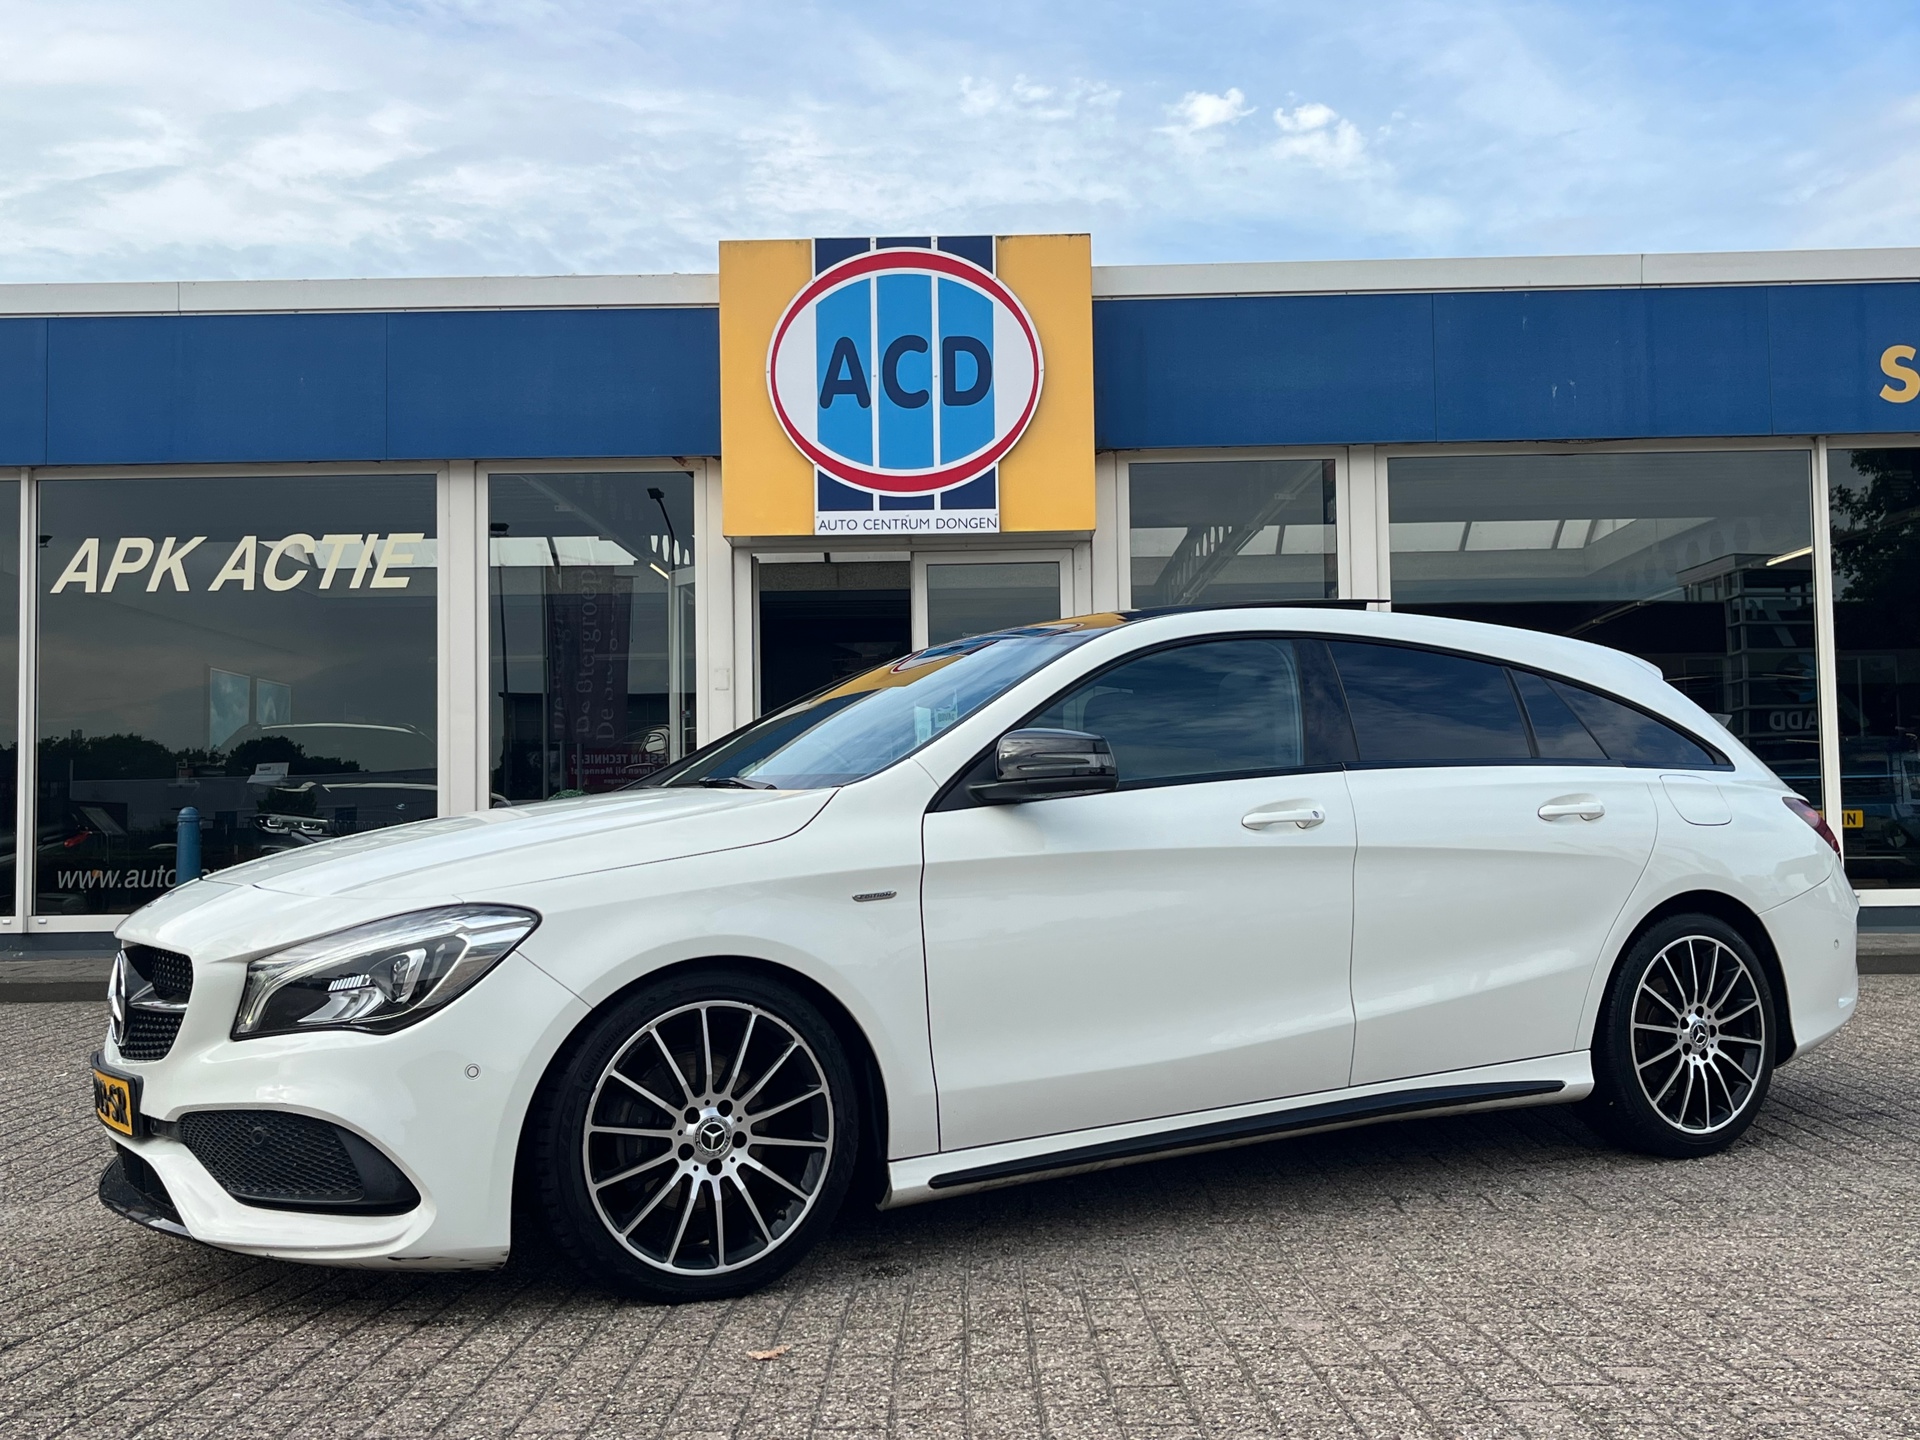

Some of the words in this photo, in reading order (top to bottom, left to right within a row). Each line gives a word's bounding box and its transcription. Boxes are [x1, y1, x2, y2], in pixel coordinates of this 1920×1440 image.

[819, 334, 993, 410] ACD
[818, 518, 859, 531] AUTO
[863, 517, 931, 531] CENTRUM
[935, 516, 998, 530] DONGEN
[50, 536, 208, 594] APK
[208, 532, 425, 592] ACTIE
